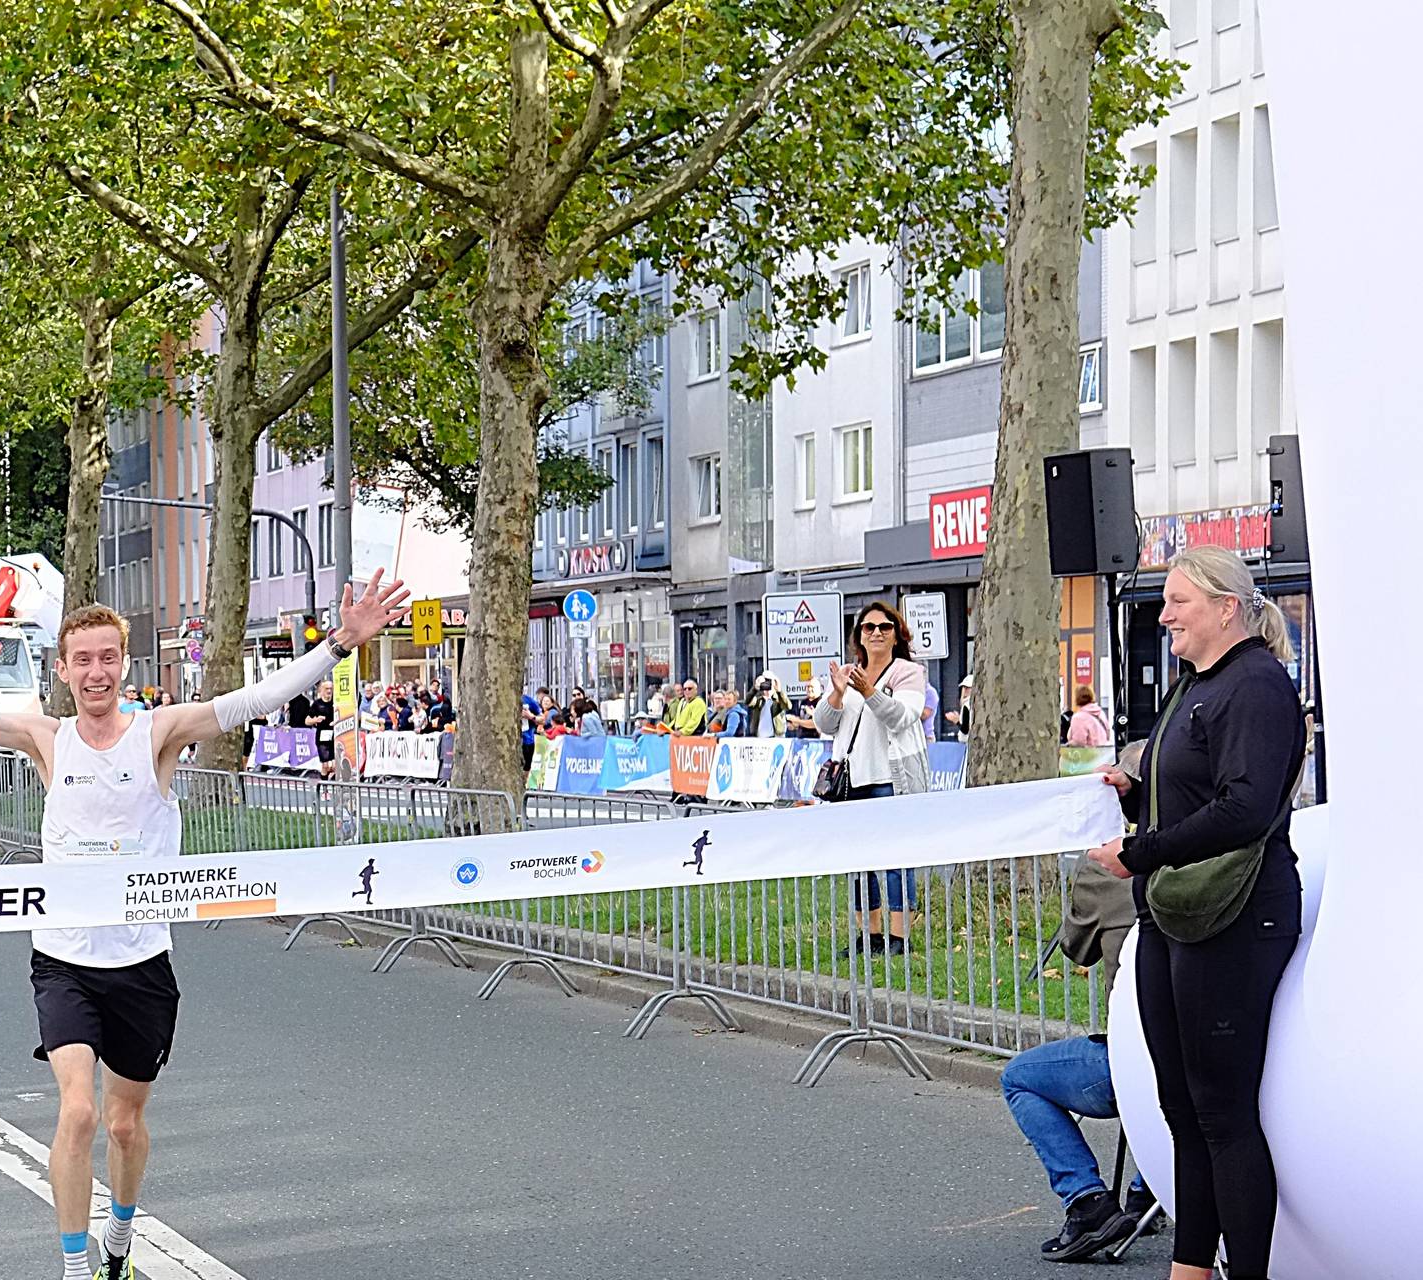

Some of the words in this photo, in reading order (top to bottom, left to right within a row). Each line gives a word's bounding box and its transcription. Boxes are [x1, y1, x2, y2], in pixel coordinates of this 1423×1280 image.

[932, 496, 987, 549] REWE
[570, 544, 614, 576] KIOSK
[419, 607, 434, 617] U8
[788, 625, 819, 634] Zufahrt
[917, 619, 934, 629] km
[779, 636, 829, 645] Marienplatz
[921, 631, 932, 648] 5
[786, 646, 823, 656] gesperrt
[509, 855, 578, 870] STADTWERKE
[127, 867, 238, 888] STADTWERKE
[533, 868, 577, 879] BOCHUM
[125, 882, 277, 906] HALBMARATHON
[125, 907, 189, 922] BOCHUM
